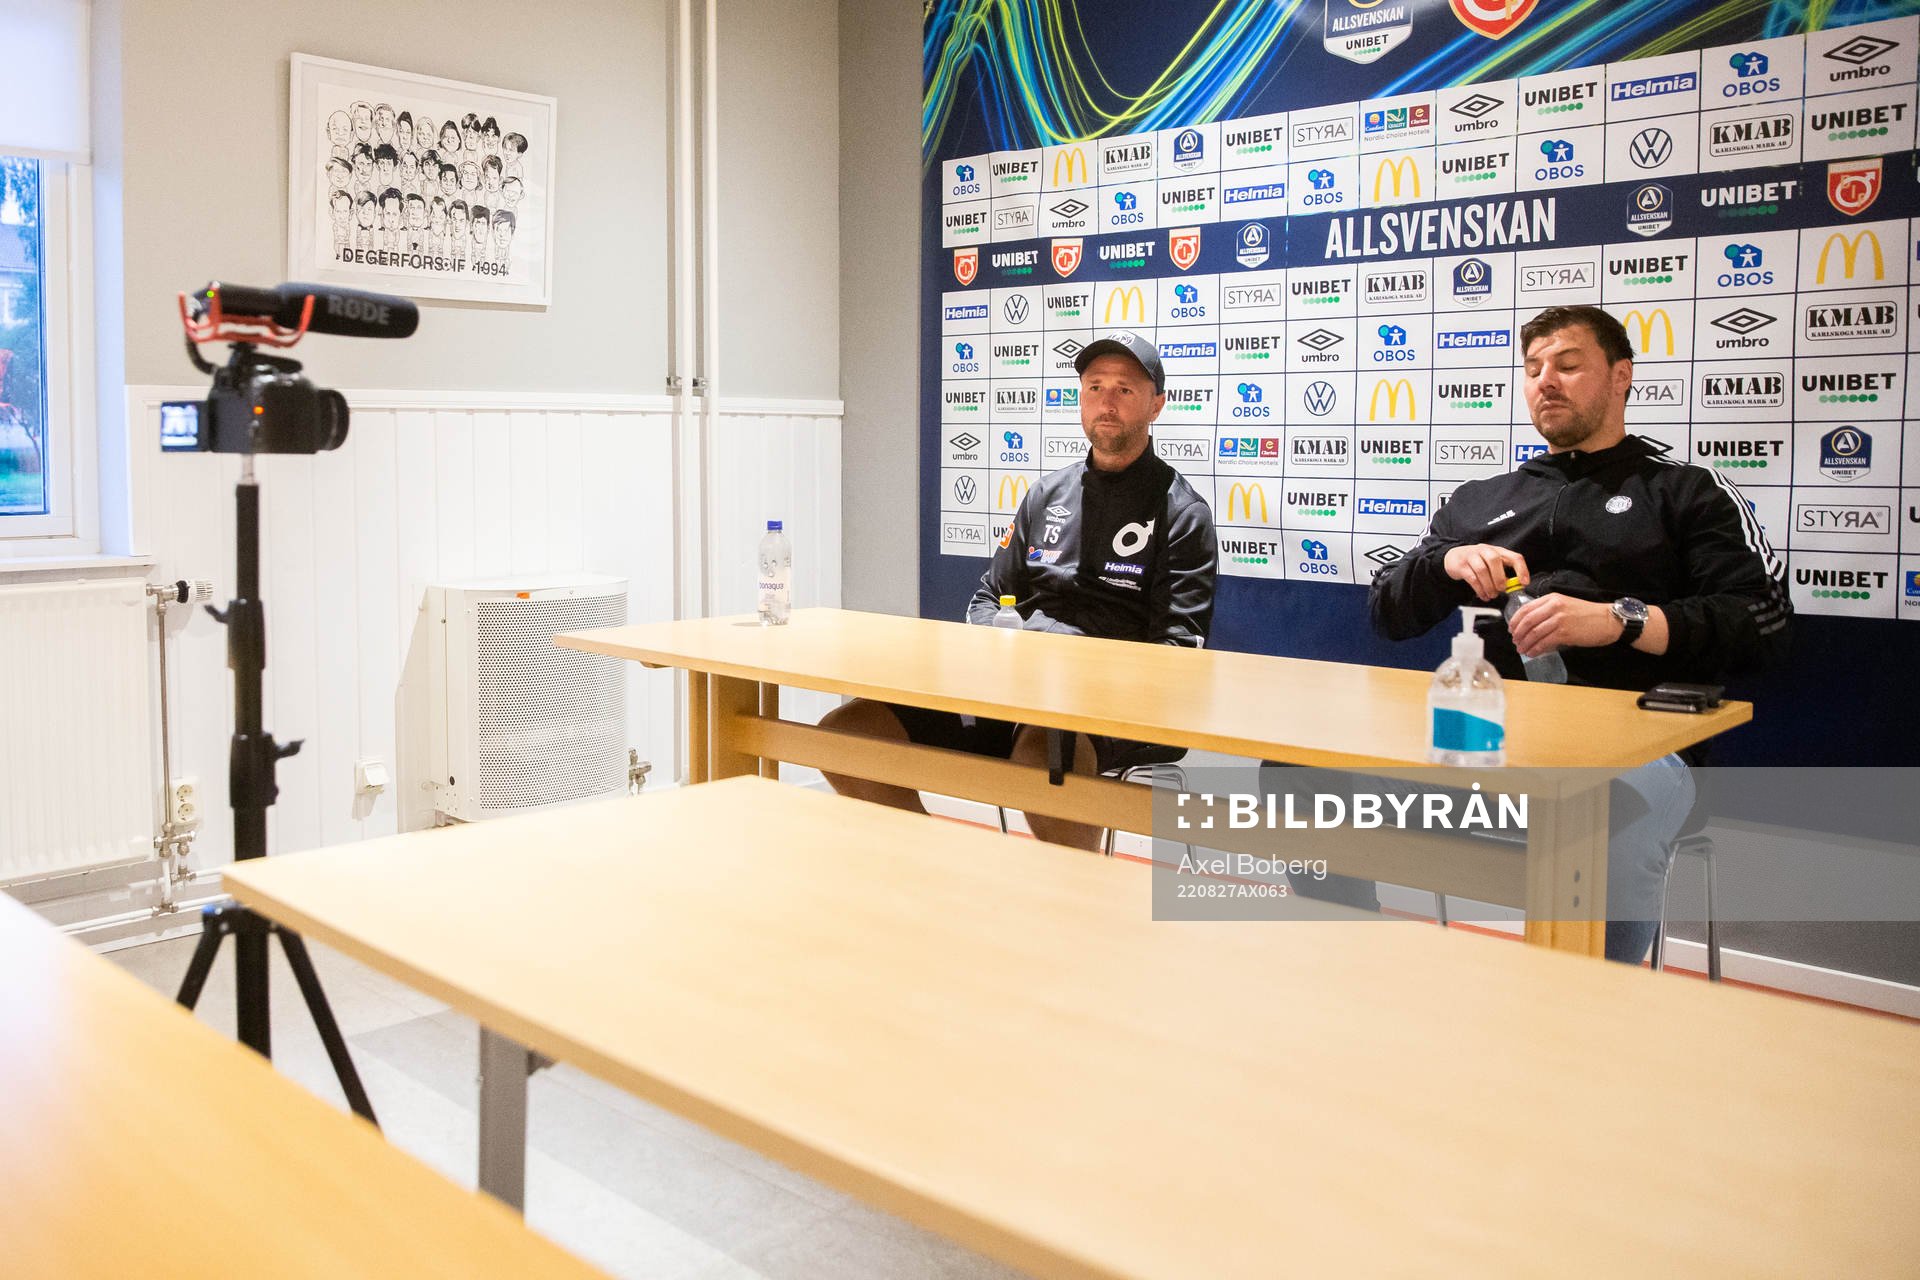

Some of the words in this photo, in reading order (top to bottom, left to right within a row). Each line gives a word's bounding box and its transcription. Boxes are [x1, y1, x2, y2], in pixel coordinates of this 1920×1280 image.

[1332, 6, 1404, 32] ALLSVENSKAN
[1346, 34, 1389, 50] UNIBET
[1829, 64, 1891, 82] umbro
[1524, 82, 1597, 107] UNIBET
[1613, 74, 1695, 100] Helmia
[1722, 78, 1780, 98] OBOS
[1811, 103, 1908, 132] UNIBET
[1454, 119, 1498, 132] umbro
[1713, 119, 1791, 145] KMAB
[1226, 127, 1283, 147] UNIBET
[1105, 145, 1150, 165] KMAB
[992, 161, 1038, 176] UNIBET
[1442, 153, 1510, 175] UNIBET
[1535, 165, 1584, 182] OBOS
[953, 184, 980, 196] OBOS
[1162, 187, 1215, 205] UNIBET
[1225, 185, 1283, 201] Helmia
[1701, 180, 1797, 208] UNIBET
[1303, 192, 1343, 206] OBOS
[946, 212, 987, 227] UNIBET
[1052, 219, 1086, 229] umbro
[1111, 212, 1144, 226] OBOS
[1631, 212, 1668, 222] ALLSVENSKAN
[1324, 197, 1556, 259] ALLSVENSKAN
[1099, 242, 1155, 260] UNIBET
[343, 248, 446, 272] DEGERFORS
[452, 259, 466, 272] IF
[475, 261, 507, 277] 1994
[992, 250, 1039, 268] UNIBET
[1609, 255, 1688, 275] UNIBET
[1291, 278, 1351, 296] UNIBET
[1367, 274, 1425, 293] KMAB
[1717, 271, 1774, 288] OBOS
[1047, 295, 1089, 309] UNIBET
[946, 306, 988, 320] Helmia
[1171, 306, 1205, 318] OBOS
[1808, 304, 1895, 327] KMAB
[1224, 336, 1281, 352] UNIBET
[1438, 332, 1508, 347] Helmia
[1716, 336, 1769, 349] umbro
[994, 344, 1039, 358] UNIBET
[1160, 344, 1216, 357] Helmia
[1301, 353, 1340, 363] umbro
[1373, 349, 1415, 362] OBOS
[952, 363, 979, 373] OBOS
[1704, 376, 1782, 396] KMAB
[1802, 373, 1897, 392] UNIBET
[946, 392, 986, 404] UNIBET
[997, 391, 1036, 404] KMAB
[1167, 389, 1213, 402] NIBET
[1438, 383, 1506, 398] UNIBET
[1232, 406, 1270, 417] OBOS
[1293, 440, 1347, 455] KMAB
[1361, 440, 1423, 455] UNIBET
[1697, 440, 1783, 457] UNIBET
[952, 453, 978, 461] umbro
[1000, 452, 1029, 463] OBOS
[1824, 457, 1866, 465] ALLSVENSKAN
[1287, 492, 1348, 508] UNIBET
[1359, 500, 1425, 515] Helmia
[1043, 525, 1061, 544] TS
[1221, 541, 1277, 555] UNIBET
[1105, 562, 1142, 574] Helmia
[1300, 562, 1338, 575] OBOS
[1796, 569, 1888, 588] UNIBET
